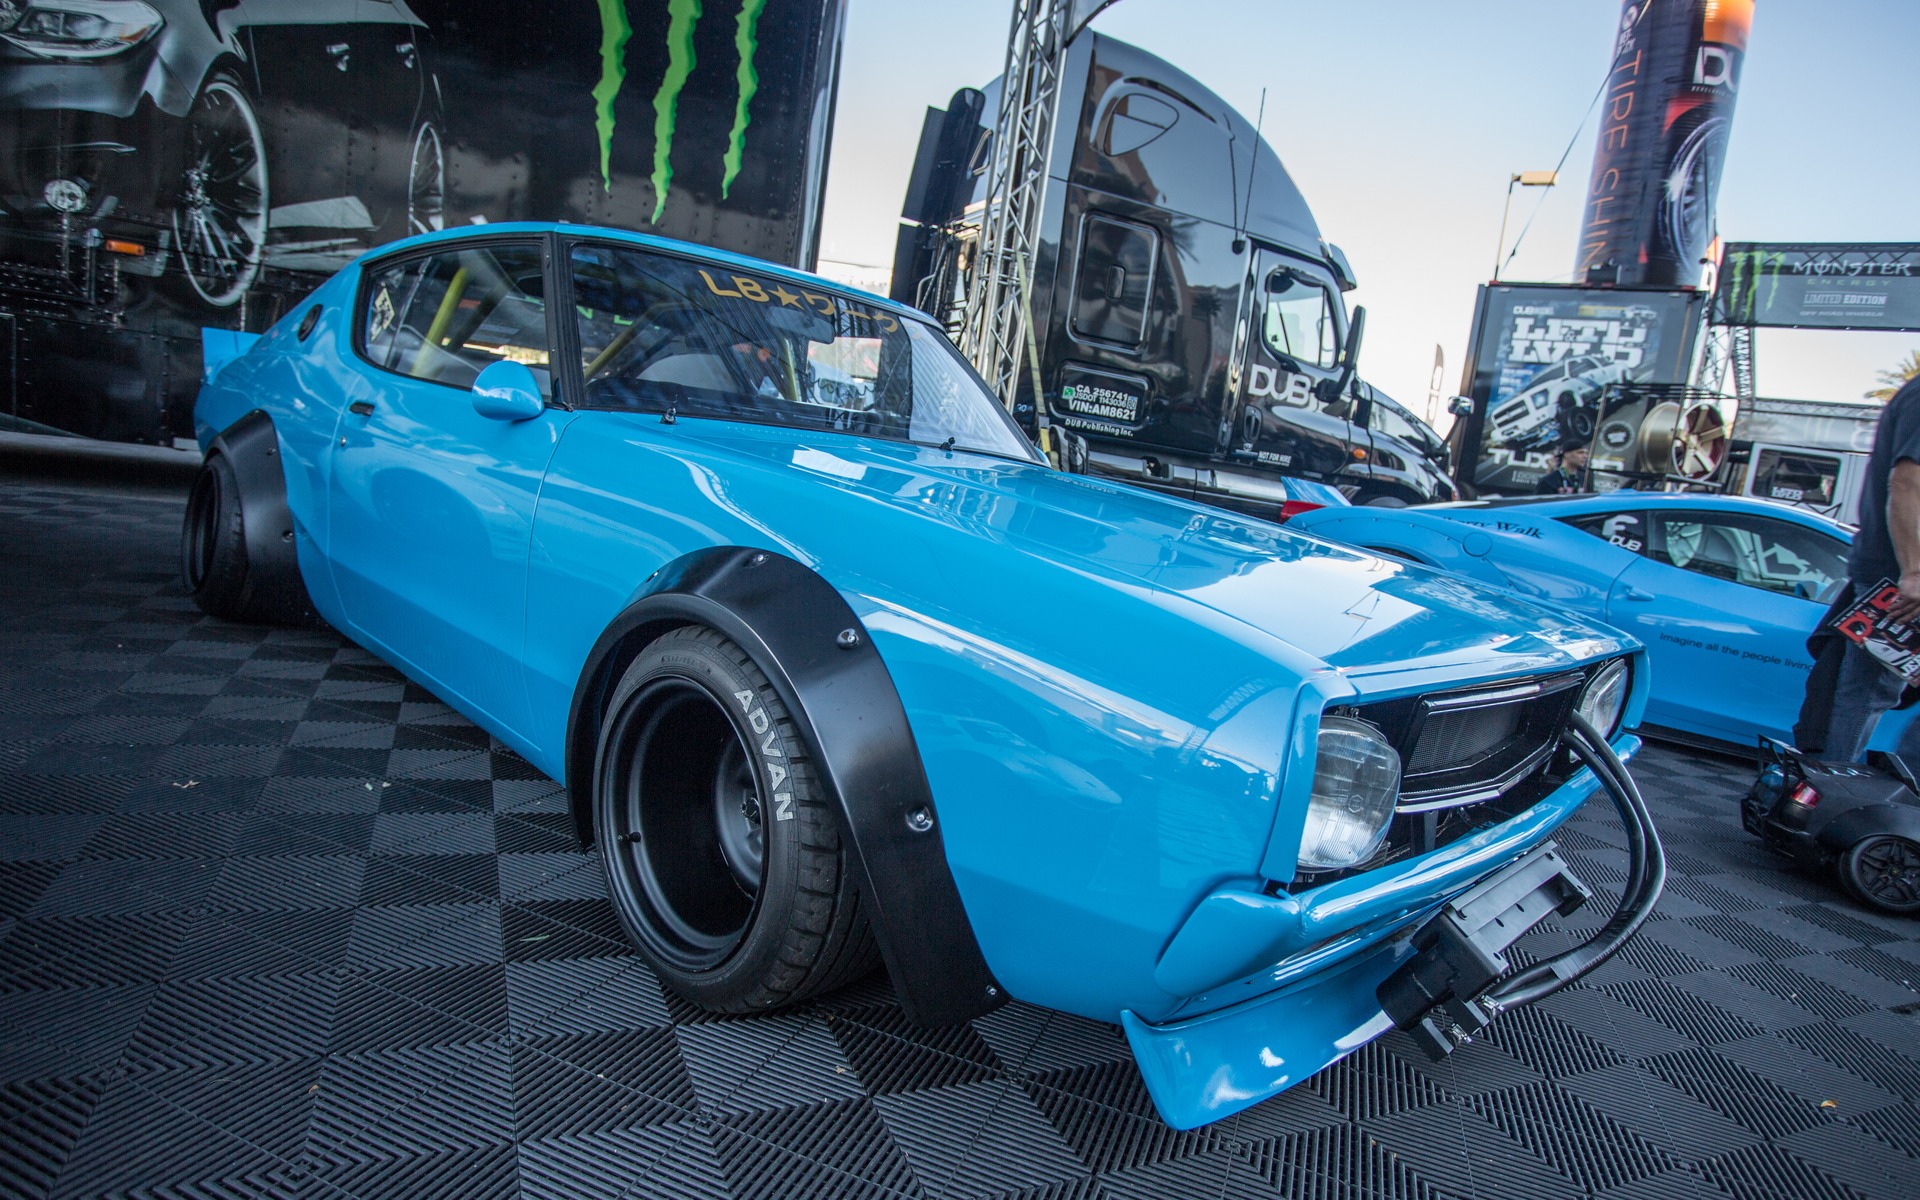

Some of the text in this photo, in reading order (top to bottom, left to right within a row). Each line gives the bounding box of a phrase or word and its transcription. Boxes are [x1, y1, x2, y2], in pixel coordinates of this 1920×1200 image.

[1601, 49, 1642, 150] TIRE
[1578, 167, 1619, 283] SHIN
[1791, 258, 1912, 277] MONSTER
[1807, 278, 1891, 287] ENERGY
[1803, 293, 1888, 305] LIMITED EDITION
[1076, 384, 1129, 401] CA 256741
[1247, 363, 1312, 406] DUB
[1074, 391, 1098, 403] USDOT
[1069, 400, 1136, 421] VIN:AM8621
[1064, 418, 1134, 437] DUB Publishing Inc.
[1496, 521, 1543, 539] Walk
[1609, 534, 1642, 551] DUB
[1659, 632, 1703, 648] Imagine
[1705, 643, 1719, 651] all
[1722, 646, 1740, 656] the
[1741, 651, 1782, 665] people
[733, 689, 794, 821] ADVAN
